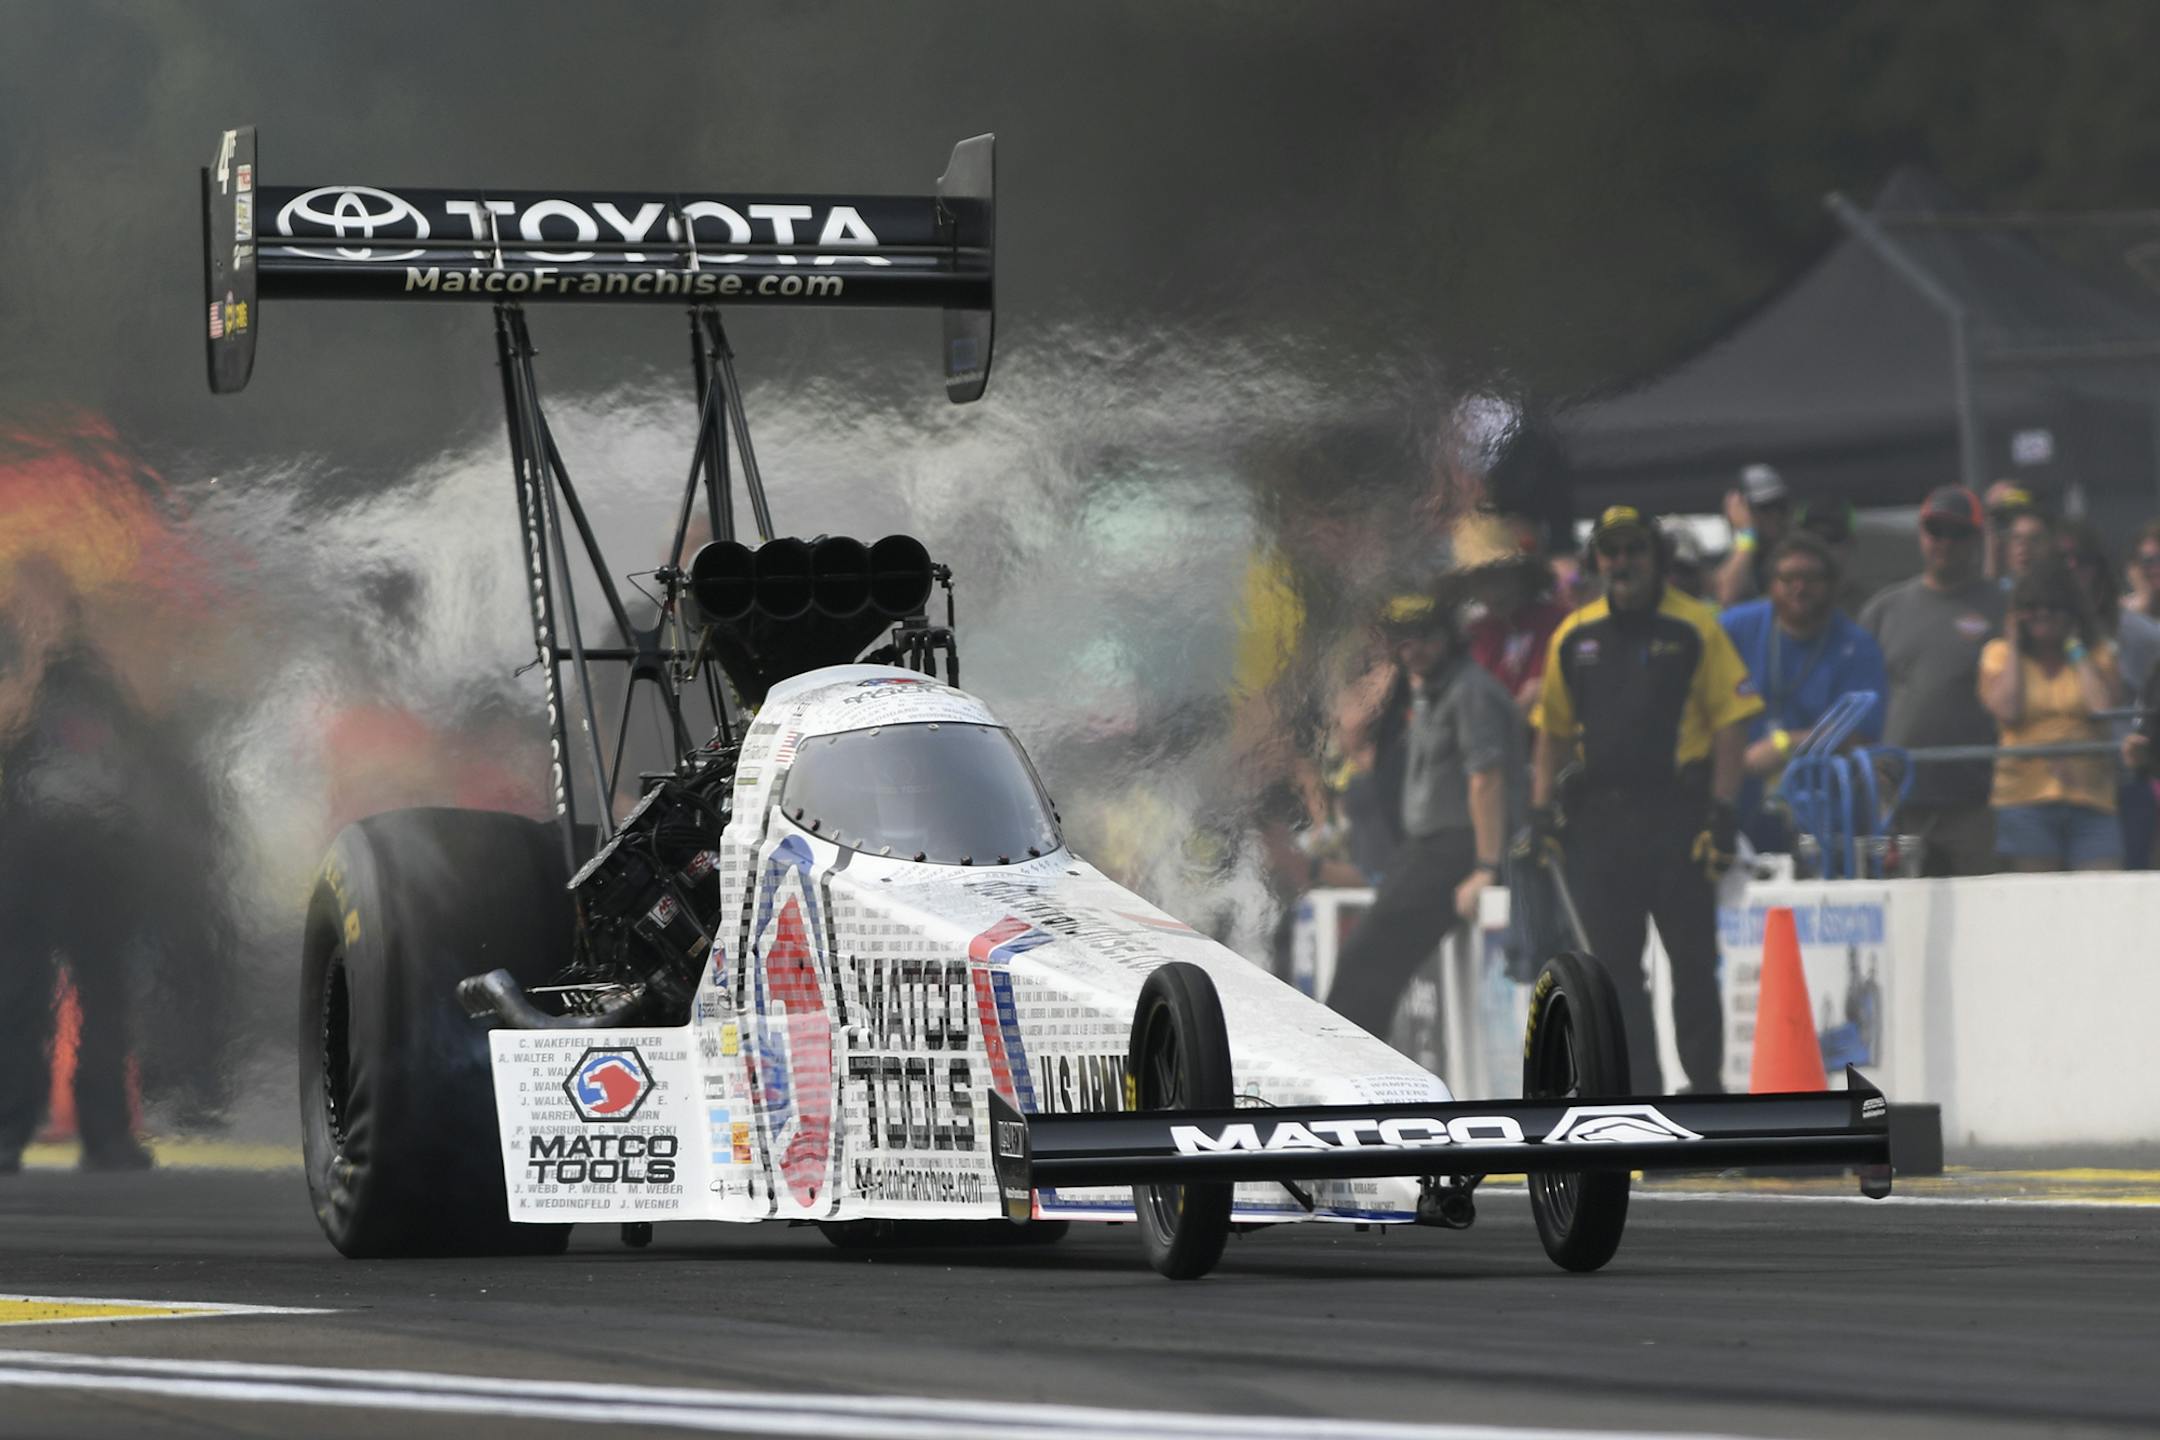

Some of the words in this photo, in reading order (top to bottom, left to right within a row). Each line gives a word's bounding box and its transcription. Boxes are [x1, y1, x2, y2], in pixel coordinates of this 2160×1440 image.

[446, 199, 893, 266] TOYOTA
[404, 267, 845, 297] MatcoFranchise.com
[534, 1038, 594, 1048] WAKEFIELD
[619, 1037, 662, 1047] WALKER
[514, 1053, 554, 1063] WALTER
[647, 1052, 688, 1061] WALLIN
[848, 1056, 976, 1151] TOOLS
[531, 1111, 577, 1121] WARREN
[529, 1125, 589, 1135] WASHBURN
[1170, 1117, 1524, 1156] MATCO
[529, 1135, 679, 1158] MATCO
[528, 1160, 676, 1184] TOOLS
[528, 1184, 559, 1194] WEBB
[582, 1184, 618, 1194] WEBEL
[646, 1184, 684, 1194] WEBER
[535, 1199, 611, 1209] WEDDINGFELD
[634, 1200, 679, 1209] WEGNER
